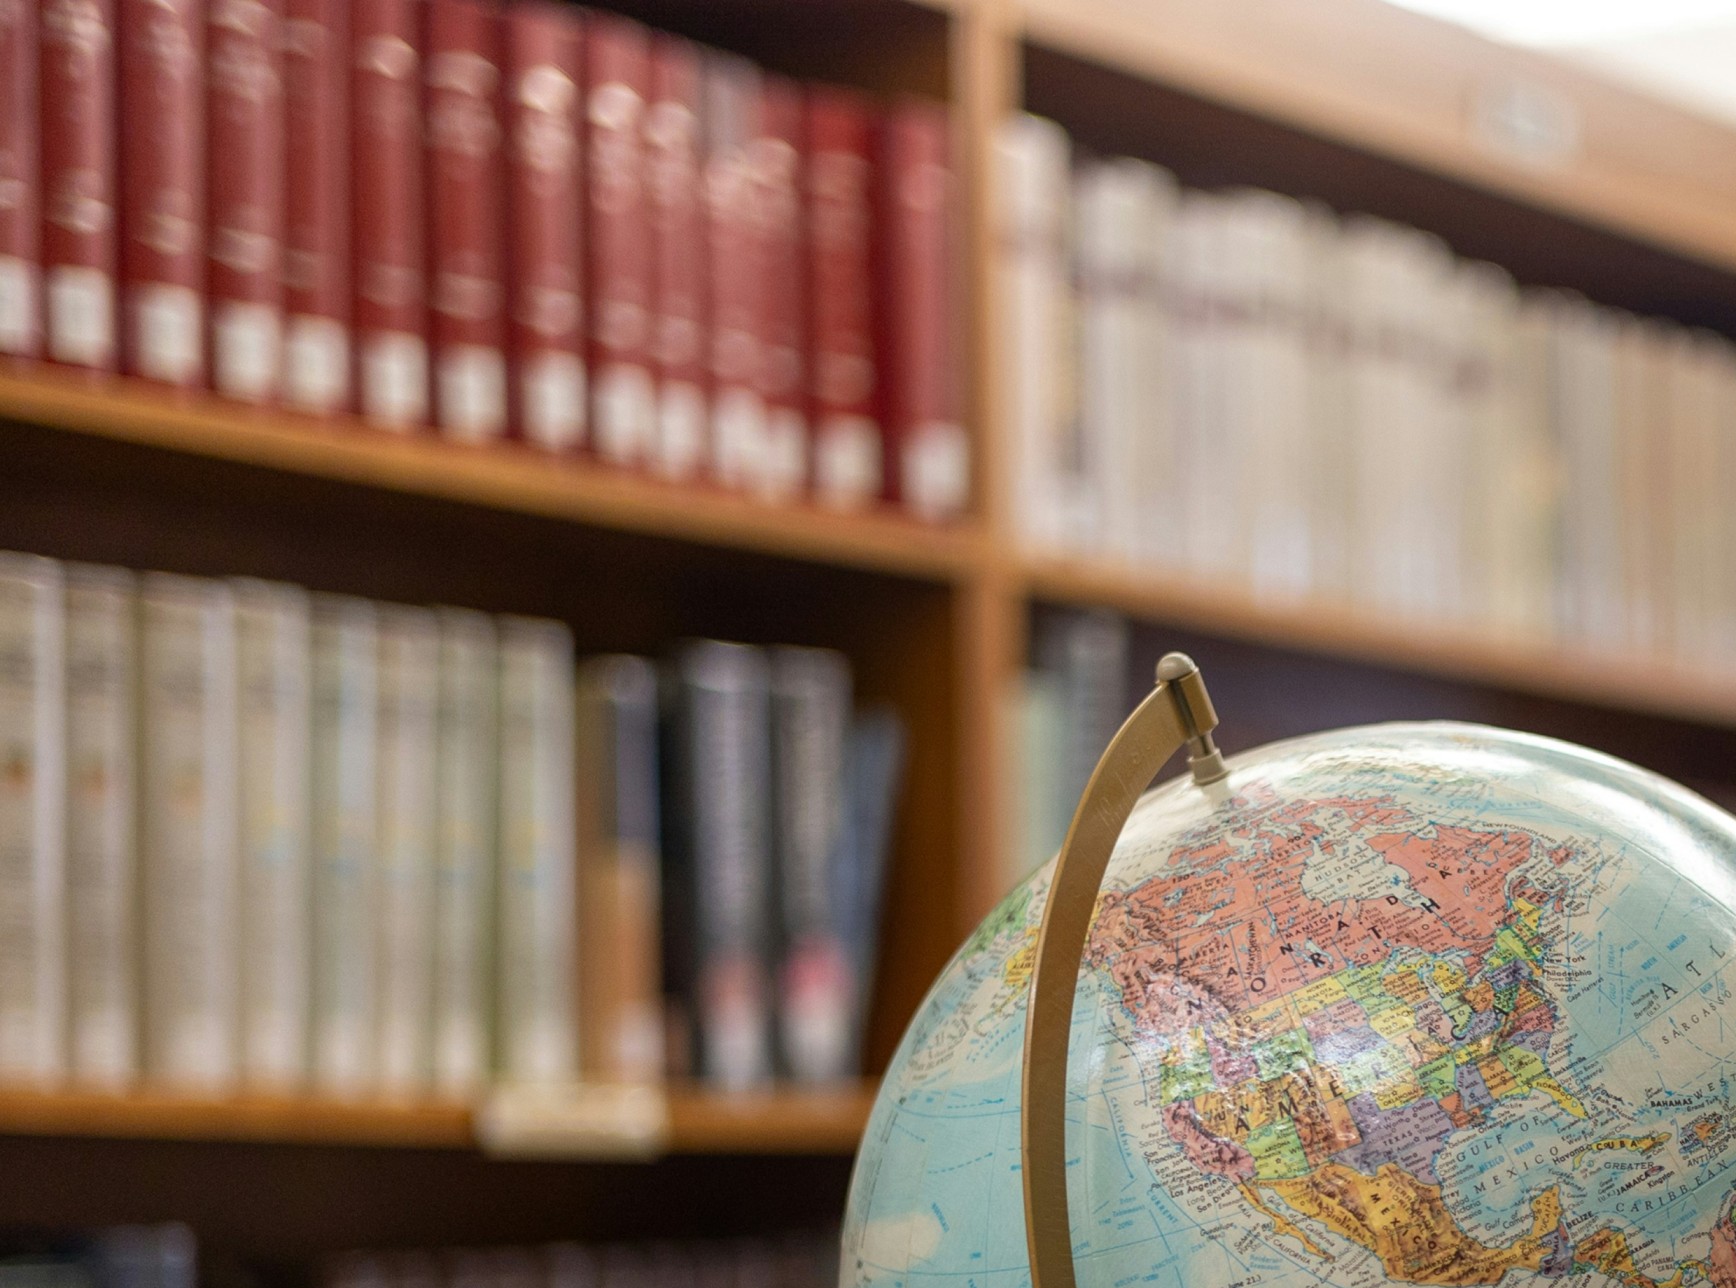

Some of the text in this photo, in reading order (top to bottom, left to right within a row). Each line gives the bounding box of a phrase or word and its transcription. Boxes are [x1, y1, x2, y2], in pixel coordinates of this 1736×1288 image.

[1482, 823, 1557, 844] NEWFOUNDLAND
[1314, 852, 1368, 883] HUDSON
[1285, 912, 1343, 939] MANITOBA
[1245, 921, 1257, 980] SASKATCHEWAN
[1543, 957, 1561, 965] New
[1306, 982, 1327, 994] NORTH
[1307, 987, 1333, 1001] DAKOTA
[1440, 986, 1466, 999] Detroit
[1402, 1000, 1438, 1017] Chicago
[1661, 989, 1732, 1045] SARGASSO
[1418, 1063, 1448, 1081] ARKANSAS
[1514, 1058, 1539, 1072] GEORGIA
[1554, 1056, 1587, 1076] Jacksonville
[1412, 1100, 1434, 1112] Dallas
[1651, 1098, 1693, 1108] BAHAMAS
[1111, 1096, 1132, 1158] CALIFORNIA
[1265, 1140, 1290, 1153] ARIZONA
[1384, 1129, 1413, 1146] TEXAS
[1456, 1115, 1541, 1163] GULF OF
[1144, 1150, 1157, 1159] San
[1147, 1152, 1181, 1165] Francisco
[1553, 1145, 1589, 1165] Havana
[1687, 1144, 1729, 1167] ANTILLES
[1473, 1146, 1560, 1194] MEXICO
[1603, 1162, 1654, 1170] GREATER
[1171, 1177, 1221, 1198] Los Angeles
[1615, 1171, 1651, 1197] JAMAICA
[1616, 1159, 1729, 1213] CARIBBEAN
[1647, 1170, 1675, 1189] Kingston
[1147, 1188, 1178, 1224] CURRENT
[1197, 1185, 1235, 1214] San Diego
[1485, 1210, 1539, 1231] Gulf Campeche
[1566, 1211, 1594, 1228] BELIZE
[1273, 1239, 1311, 1265] CALIFORNIA
[1424, 1255, 1452, 1272] Mexico
[1246, 1274, 1262, 1287] 21.)
